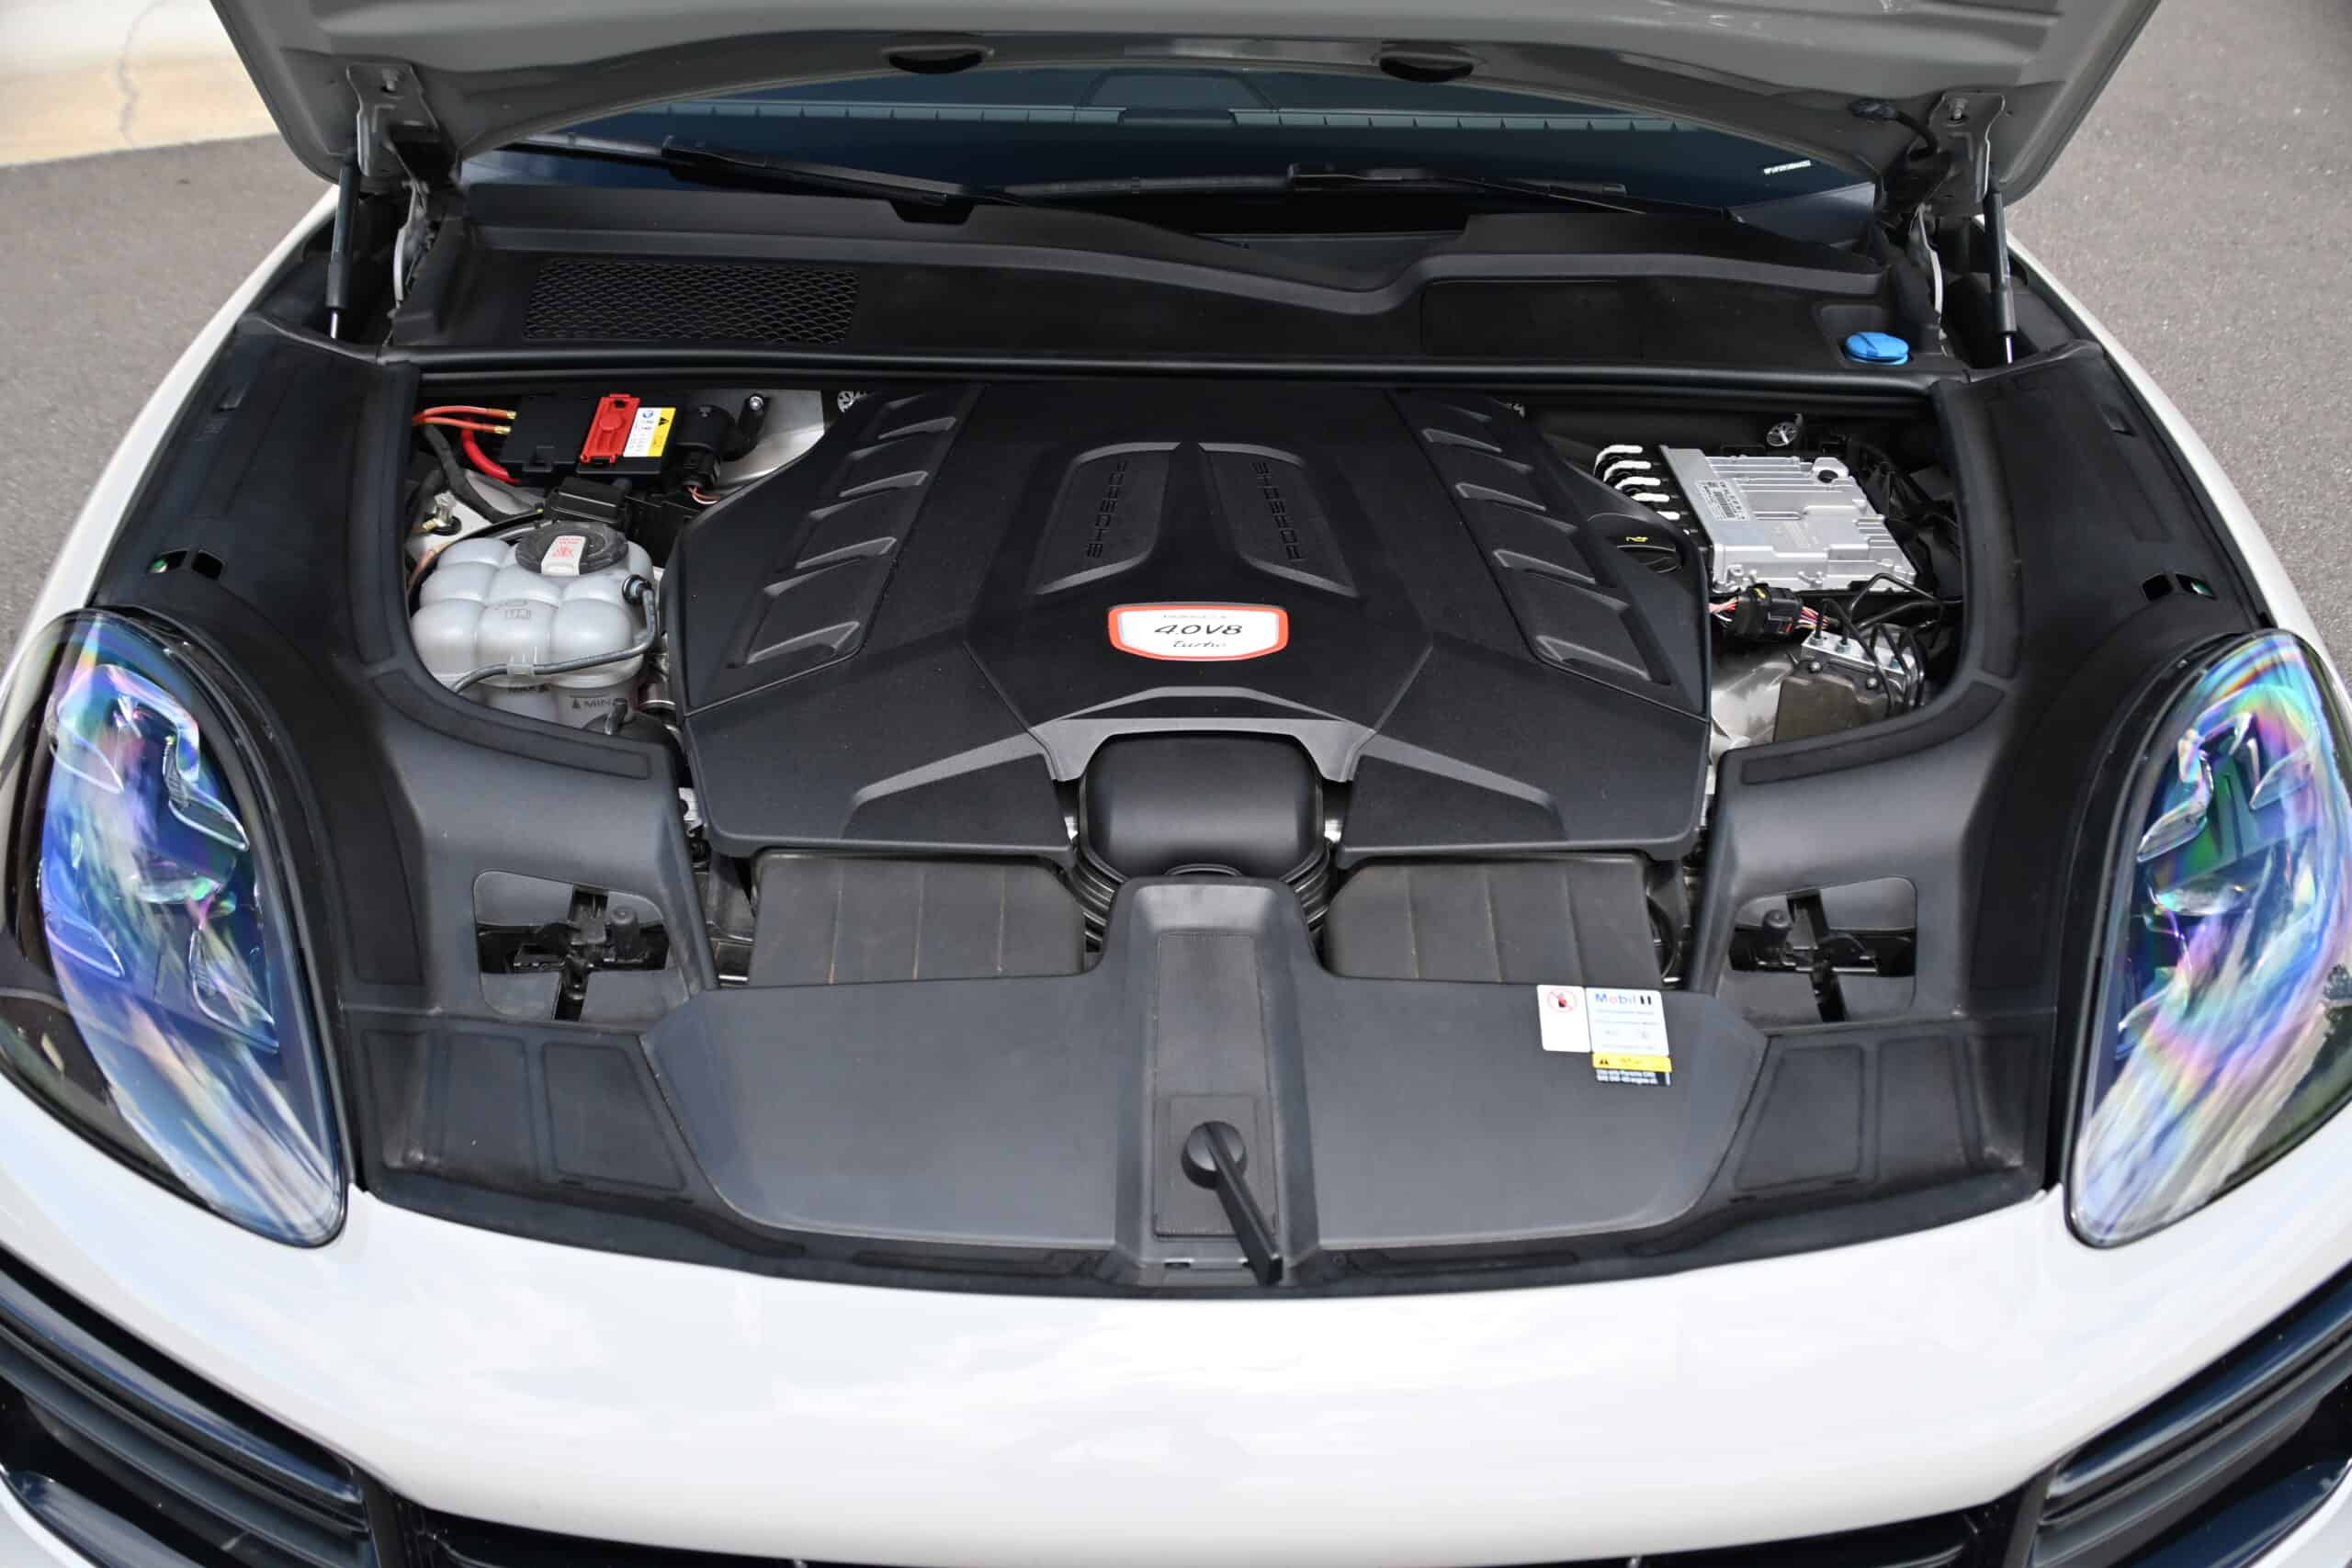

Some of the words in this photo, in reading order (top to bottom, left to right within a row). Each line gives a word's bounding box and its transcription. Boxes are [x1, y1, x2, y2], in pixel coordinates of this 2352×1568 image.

[1086, 461, 1128, 558] PORSCHE
[1250, 462, 1304, 561] PORSCHE
[1595, 993, 1636, 1005] Mobil
